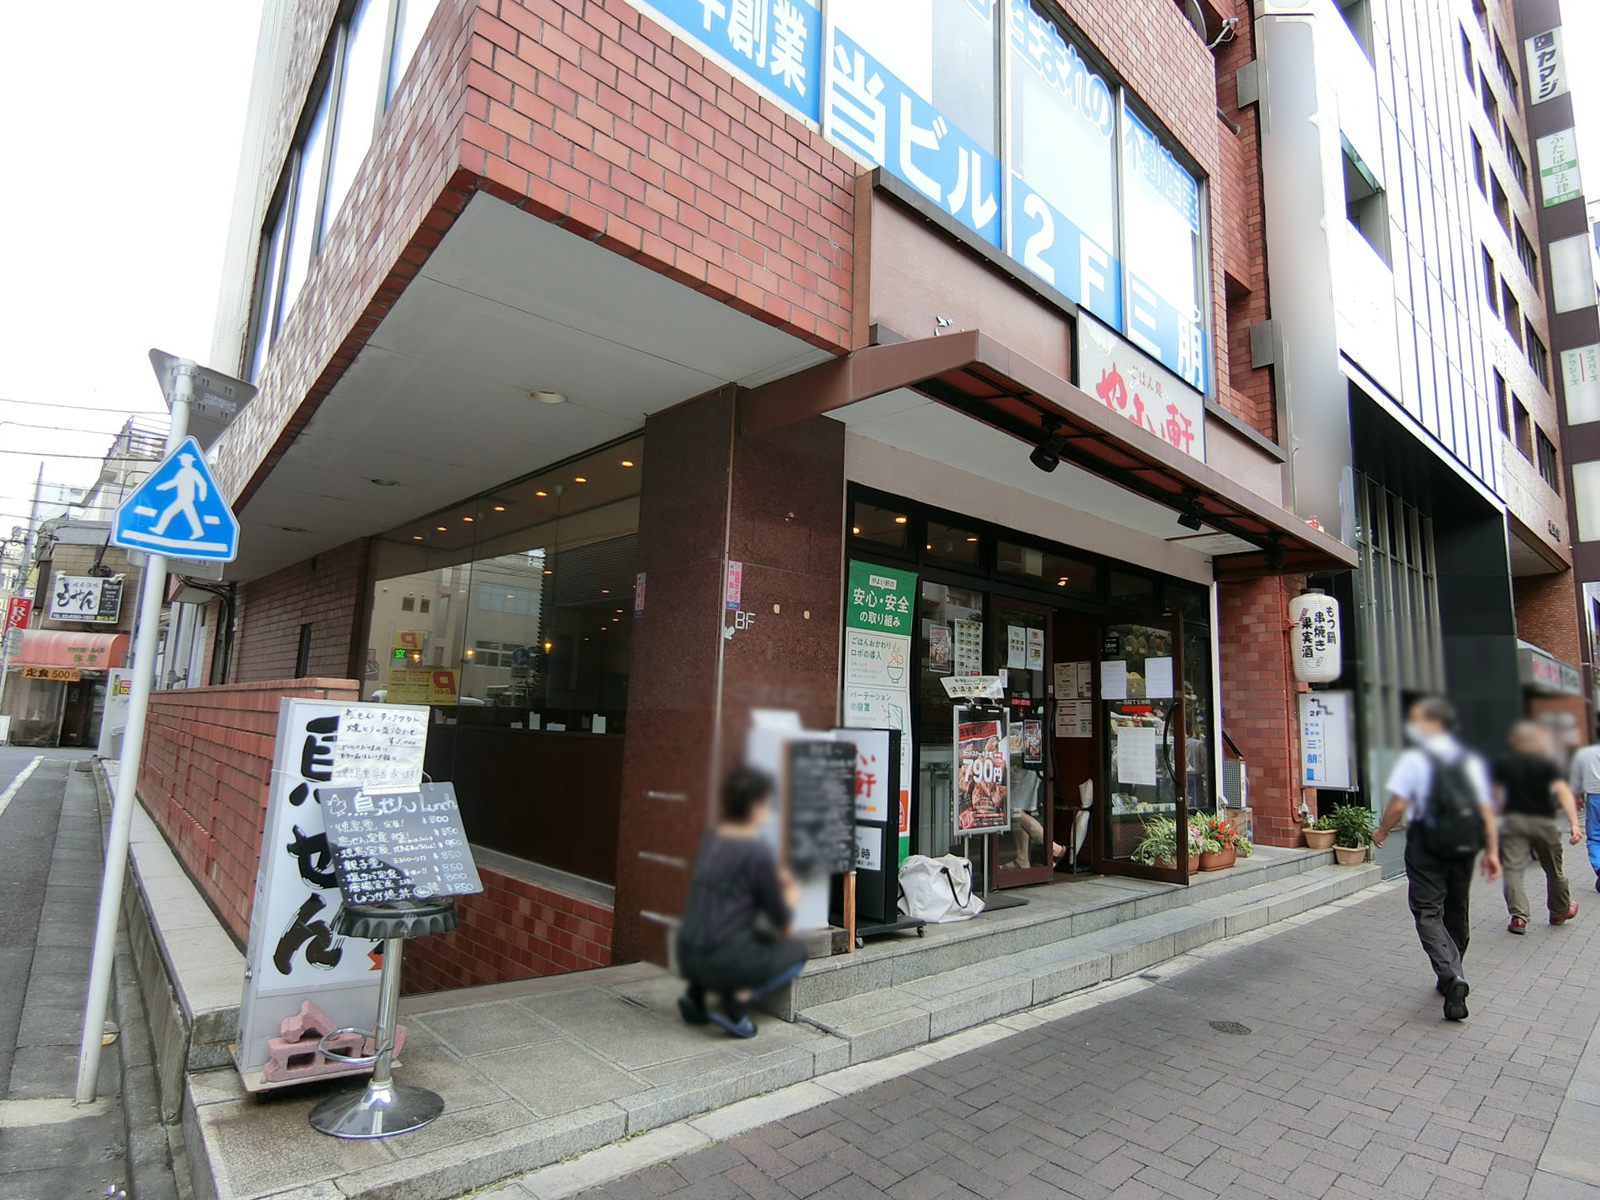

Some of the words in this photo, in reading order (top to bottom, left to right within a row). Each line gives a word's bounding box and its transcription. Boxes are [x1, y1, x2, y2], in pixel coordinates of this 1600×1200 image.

[832, 44, 998, 230] 当ビル
[853, 588, 910, 614] 安心・安全
[735, 610, 756, 630] BF
[859, 611, 901, 628] の取り組み
[1314, 611, 1326, 652] 串焼き
[1326, 606, 1337, 645] もつ鍋
[1301, 616, 1314, 659] 果実酒
[25, 668, 49, 678] 定食
[963, 758, 1003, 784] 790円
